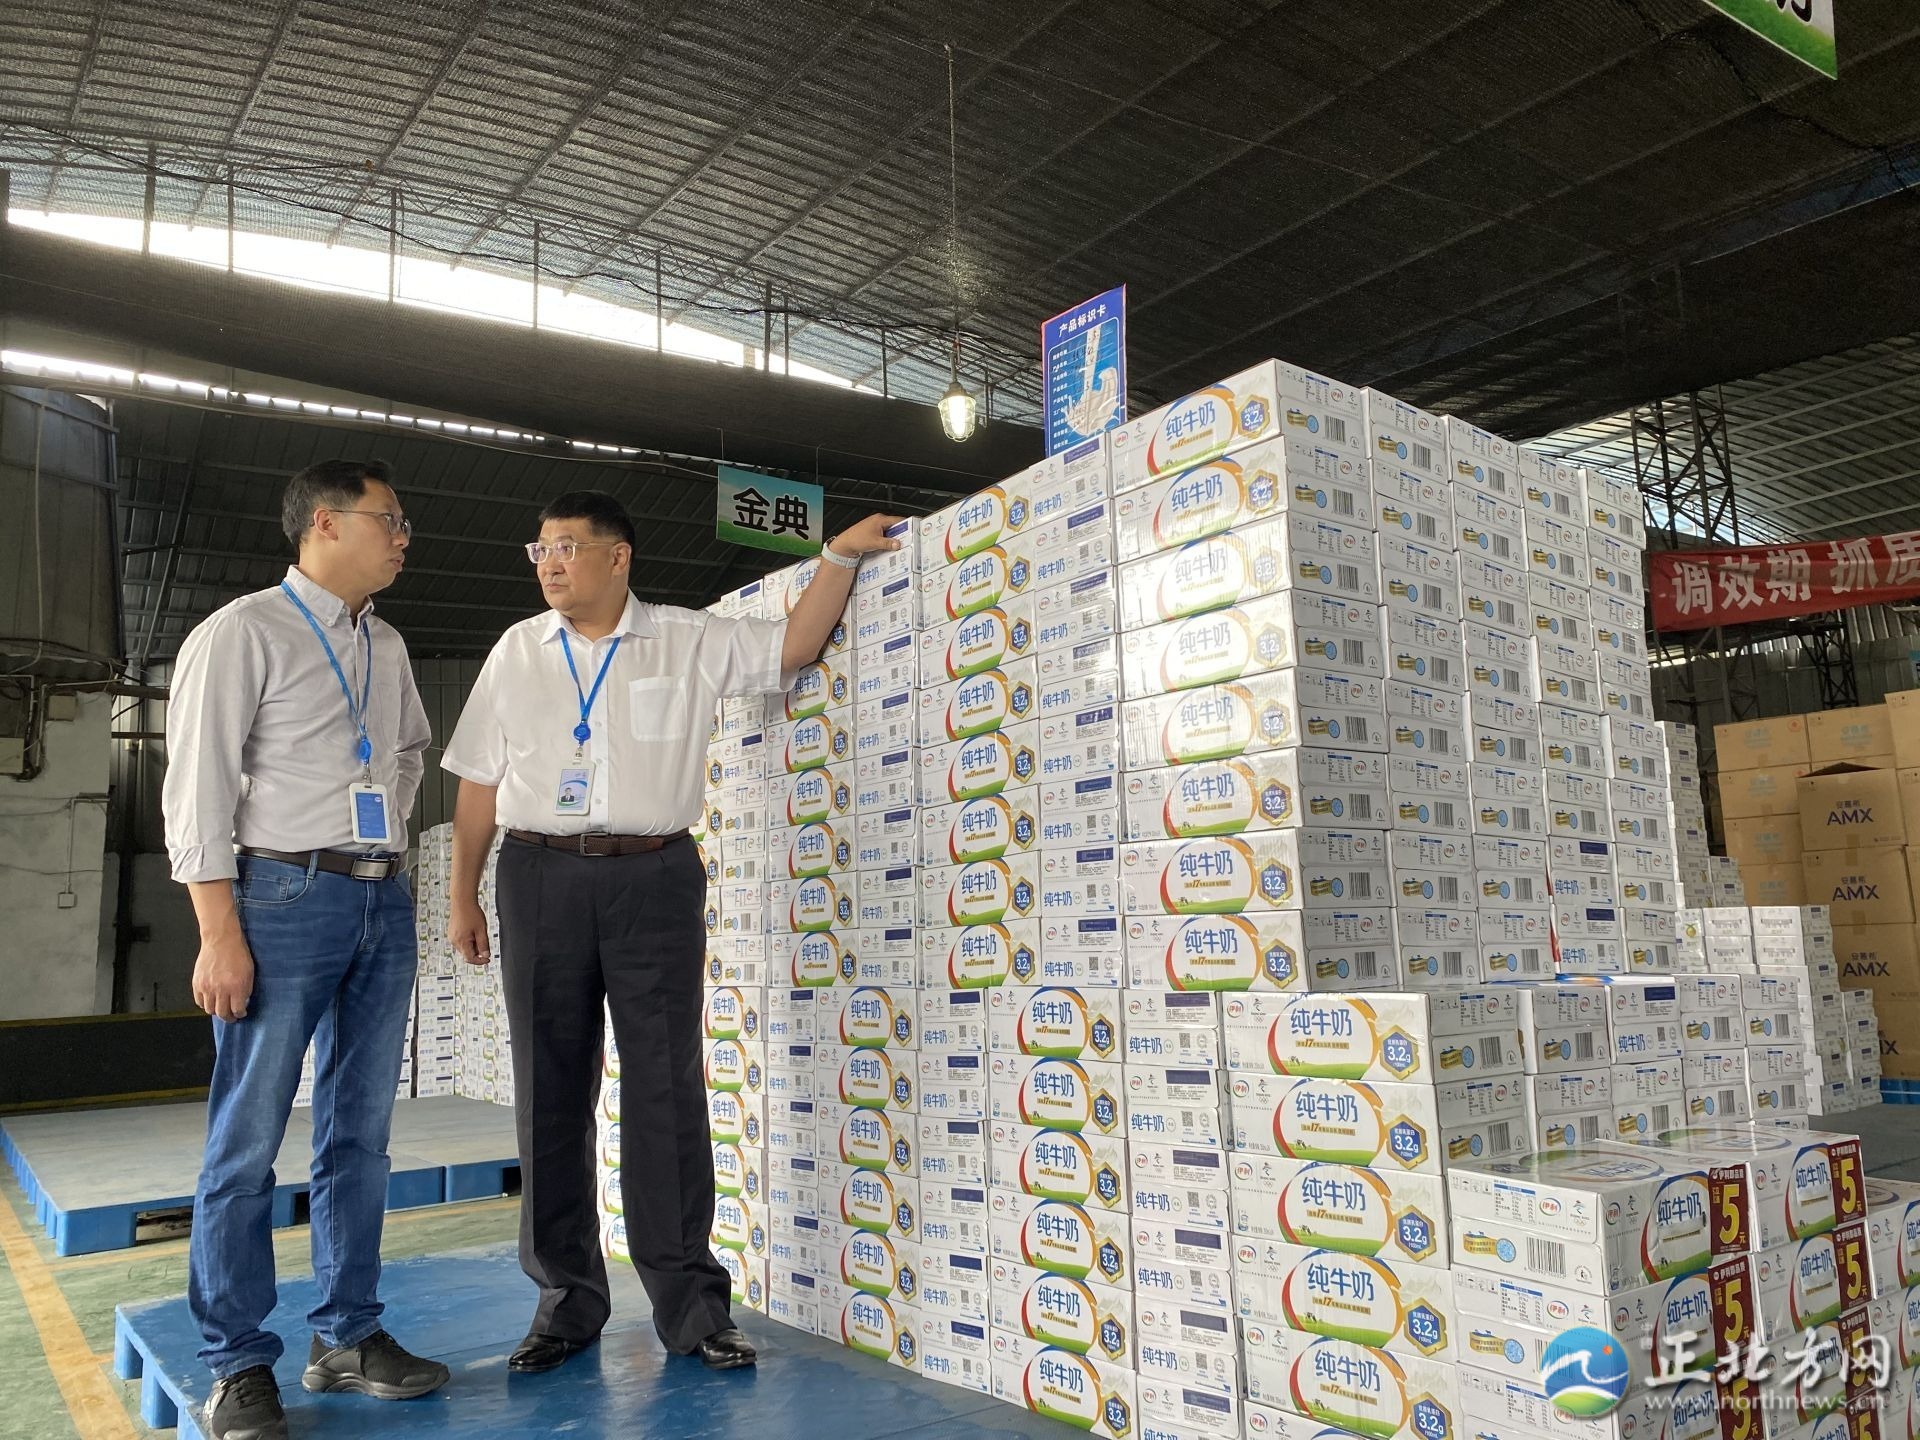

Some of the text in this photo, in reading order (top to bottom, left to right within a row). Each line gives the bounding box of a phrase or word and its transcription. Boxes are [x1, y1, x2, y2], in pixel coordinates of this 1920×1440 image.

[1059, 304, 1107, 338] 产品标识卡
[1166, 401, 1216, 441] 纯牛奶
[1172, 474, 1223, 511] 纯牛奶
[733, 487, 809, 540] 金典
[959, 498, 992, 530] 纯牛奶
[858, 567, 879, 584] 纯牛奶
[959, 557, 993, 588] 纯牛奶
[1038, 558, 1066, 580] 纯牛奶
[1175, 548, 1228, 583] 纯牛奶
[1672, 549, 1811, 615] 调效期
[859, 622, 879, 638] 纯牛奶
[959, 619, 994, 648] 纯牛奶
[1040, 623, 1068, 644] 纯牛奶
[1179, 622, 1231, 656] 纯牛奶
[794, 671, 820, 693] 纯牛奶
[860, 677, 880, 694] 纯牛奶
[959, 681, 995, 709] 纯牛奶
[1043, 689, 1071, 709] 纯牛奶
[1181, 696, 1233, 727] 纯牛奶
[795, 724, 821, 746] 纯牛奶
[859, 733, 879, 749] 纯牛奶
[961, 743, 997, 770] 纯牛奶
[1044, 755, 1072, 773] 纯牛奶
[797, 777, 823, 799] 纯牛奶
[859, 790, 879, 806] 纯牛奶
[1183, 773, 1235, 802] 纯牛奶
[1265, 796, 1285, 811] 3.2g
[962, 807, 997, 833] 纯牛奶
[1827, 808, 1874, 826] AMX
[1016, 825, 1030, 837] 3.2g
[1044, 823, 1072, 840] 纯牛奶
[799, 833, 824, 853] 纯牛奶
[860, 848, 881, 862] 纯牛奶
[1180, 850, 1233, 877] 纯牛奶
[962, 870, 997, 894] 纯牛奶
[1265, 877, 1285, 891] 3.2g
[1555, 879, 1579, 894] 纯牛奶
[800, 886, 826, 906] 纯牛奶
[1016, 891, 1030, 904] 3.2g
[1044, 891, 1073, 907] 纯牛奶
[1832, 885, 1879, 901] AMX
[862, 906, 882, 920] 纯牛奶
[962, 934, 997, 957] 纯牛奶
[1185, 928, 1238, 954] 纯牛奶
[802, 943, 829, 961] 纯牛奶
[1562, 948, 1586, 964] 纯牛奶
[862, 963, 881, 978] 纯牛奶
[1016, 958, 1030, 971] 3.2g
[1045, 962, 1073, 977] 纯牛奶
[1270, 956, 1290, 973] 3.2g
[1843, 962, 1890, 977] AMX
[851, 1000, 881, 1019] 纯牛奶
[1032, 1001, 1073, 1025] 纯牛奶
[1291, 1008, 1352, 1036] 纯牛奶
[924, 1030, 948, 1045] 纯牛奶
[1095, 1031, 1110, 1045] 3.2g
[1130, 1036, 1162, 1054] 纯牛奶
[1618, 1035, 1646, 1053] 纯牛奶
[1387, 1046, 1411, 1064] 3.2g
[851, 1058, 881, 1079] 纯牛奶
[1034, 1071, 1075, 1097] 纯牛奶
[924, 1094, 948, 1109] 纯牛奶
[1296, 1091, 1358, 1123] 纯牛奶
[1097, 1106, 1112, 1120] 3.2g
[1132, 1114, 1165, 1132] 纯牛奶
[851, 1119, 881, 1141] 纯牛奶
[1394, 1134, 1419, 1153] 3.2g
[923, 1158, 947, 1173] 纯牛奶
[1035, 1141, 1077, 1169] 纯牛奶
[1796, 1162, 1830, 1188] 纯牛奶
[852, 1179, 883, 1203] 纯牛奶
[1100, 1179, 1115, 1195] 3.2g
[1302, 1177, 1365, 1212] 纯牛奶
[1841, 1158, 1862, 1214] 5 元
[1136, 1191, 1170, 1212] 纯牛奶
[1658, 1193, 1702, 1227] 纯牛奶
[1719, 1184, 1739, 1244] 5
[1739, 1232, 1746, 1244] 元
[923, 1223, 948, 1241] 纯牛奶
[1037, 1212, 1079, 1243] 纯牛奶
[1403, 1225, 1427, 1244] 3.2g
[853, 1240, 884, 1267] 纯牛奶
[1102, 1254, 1118, 1270] 3.2g
[1801, 1249, 1833, 1277] 纯牛奶
[1138, 1267, 1173, 1289] 纯牛奶
[1846, 1242, 1867, 1299] 5 元
[1307, 1263, 1374, 1301] 纯牛奶
[924, 1288, 949, 1306] 纯牛奶
[1038, 1284, 1081, 1317] 纯牛奶
[1667, 1291, 1709, 1324] 纯牛奶
[853, 1302, 884, 1330] 纯牛奶
[1724, 1279, 1750, 1342] 5 元
[1104, 1330, 1120, 1347] 3.2g
[1413, 1321, 1438, 1340] 3.2g
[924, 1354, 950, 1374] 纯牛奶
[1143, 1347, 1178, 1371] 纯牛奶
[1040, 1357, 1084, 1393] 纯牛奶
[1315, 1350, 1380, 1392] 纯牛奶
[1108, 1408, 1125, 1425] 3.2g
[1733, 1378, 1758, 1440] 5 元
[1418, 1413, 1444, 1434] 3.2g
